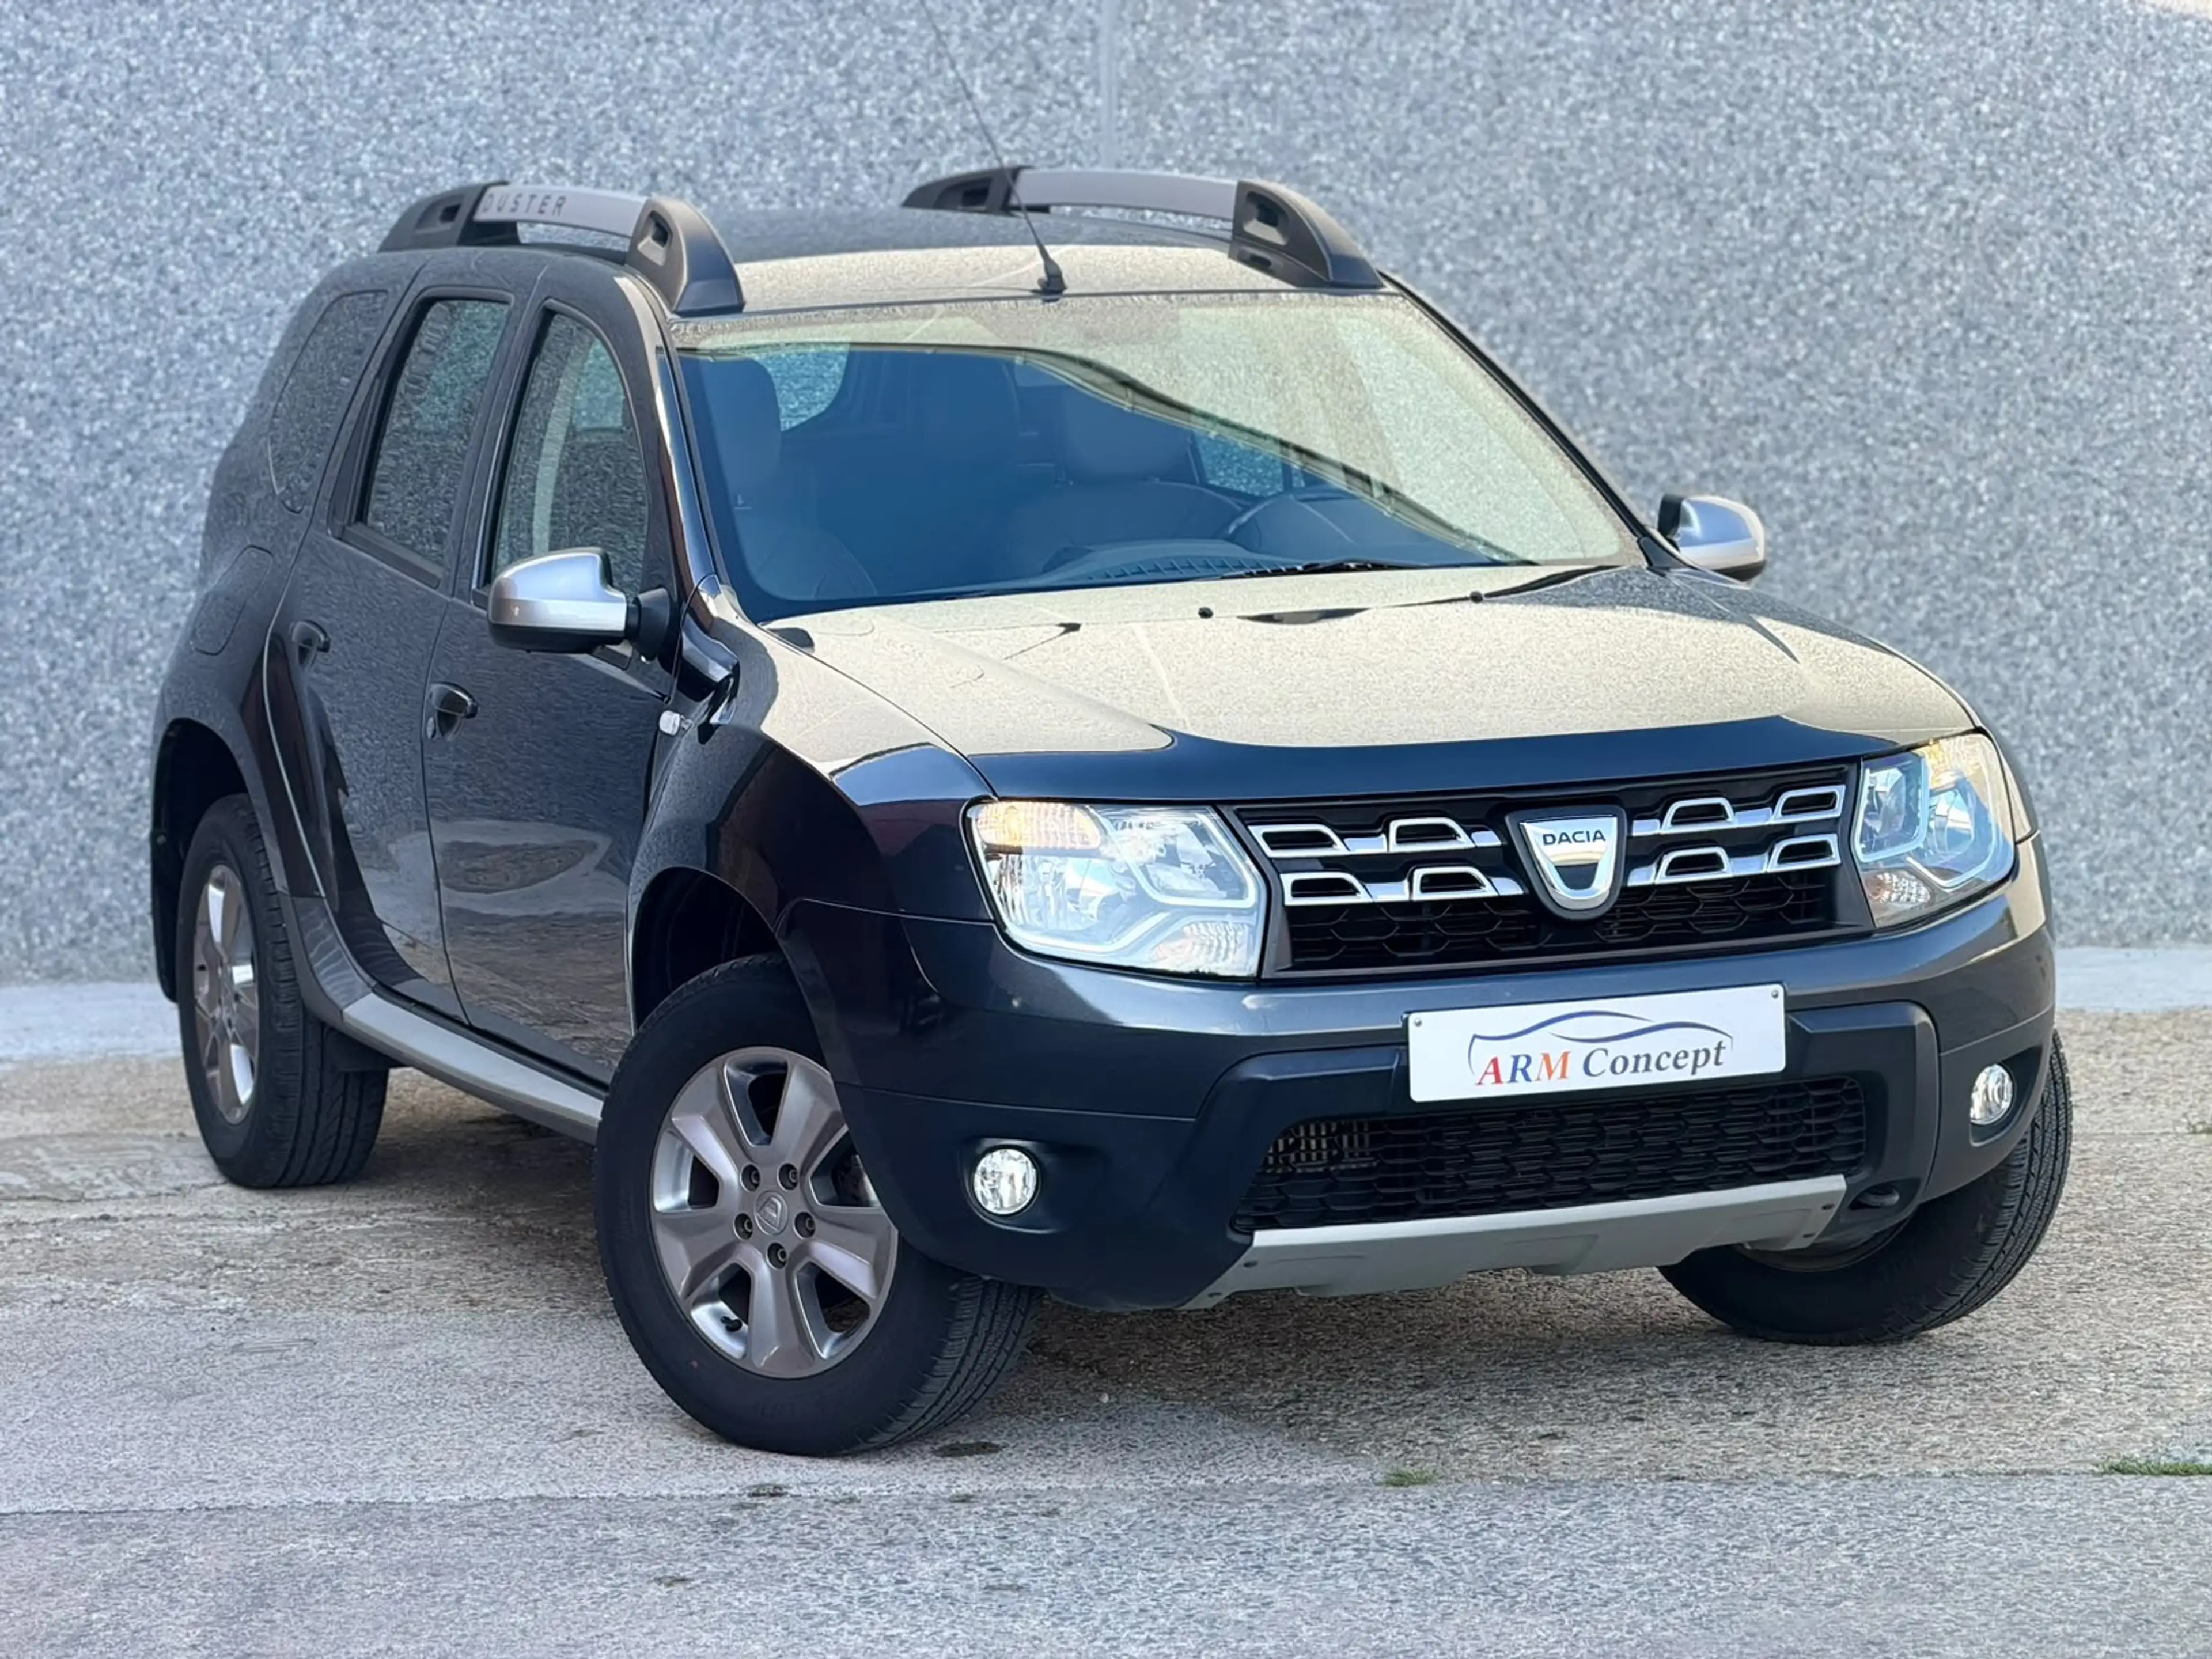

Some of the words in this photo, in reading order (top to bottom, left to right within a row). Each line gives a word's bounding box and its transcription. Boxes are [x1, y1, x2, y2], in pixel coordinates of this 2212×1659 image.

[482, 192, 566, 217] DUSTER
[1543, 830, 1606, 846] DACIA
[1475, 1051, 1571, 1086] ARM
[1582, 1040, 1726, 1077] Concept
